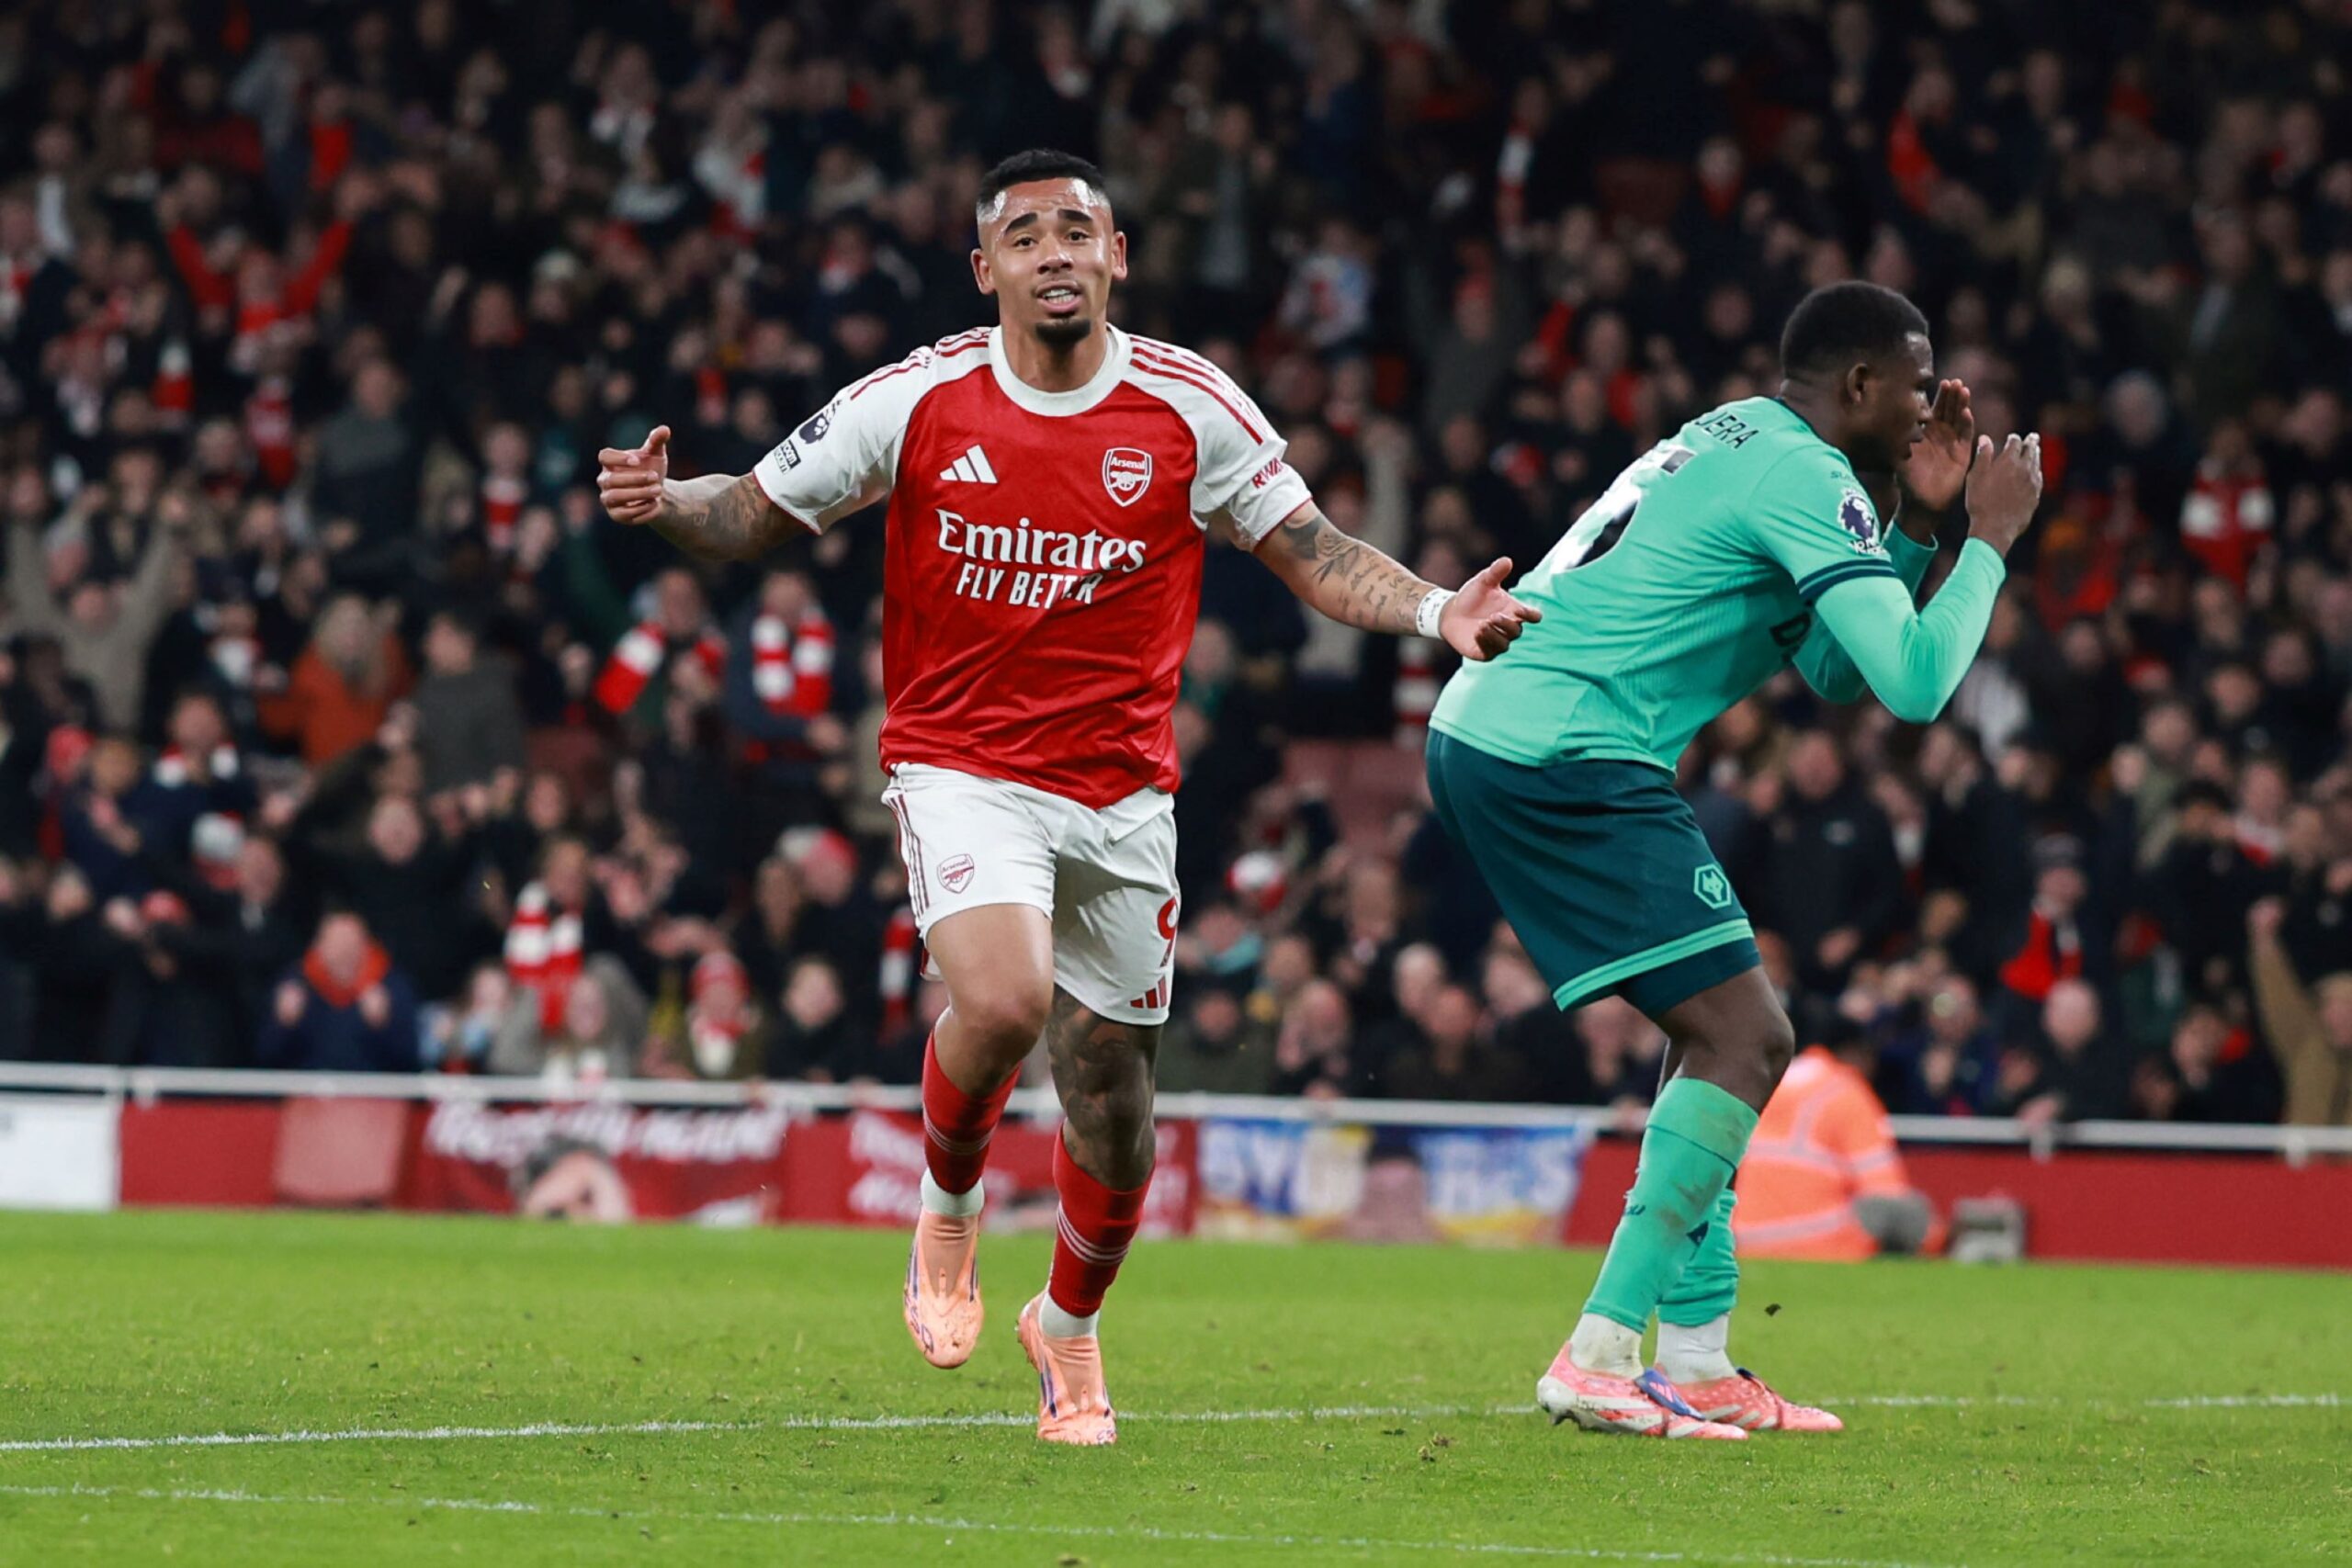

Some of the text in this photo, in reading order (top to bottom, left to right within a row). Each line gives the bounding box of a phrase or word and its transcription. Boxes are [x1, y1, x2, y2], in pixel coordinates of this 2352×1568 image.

[1110, 456, 1147, 470] Arsenal
[935, 507, 1148, 574] Emirates
[956, 561, 1006, 603] FLY
